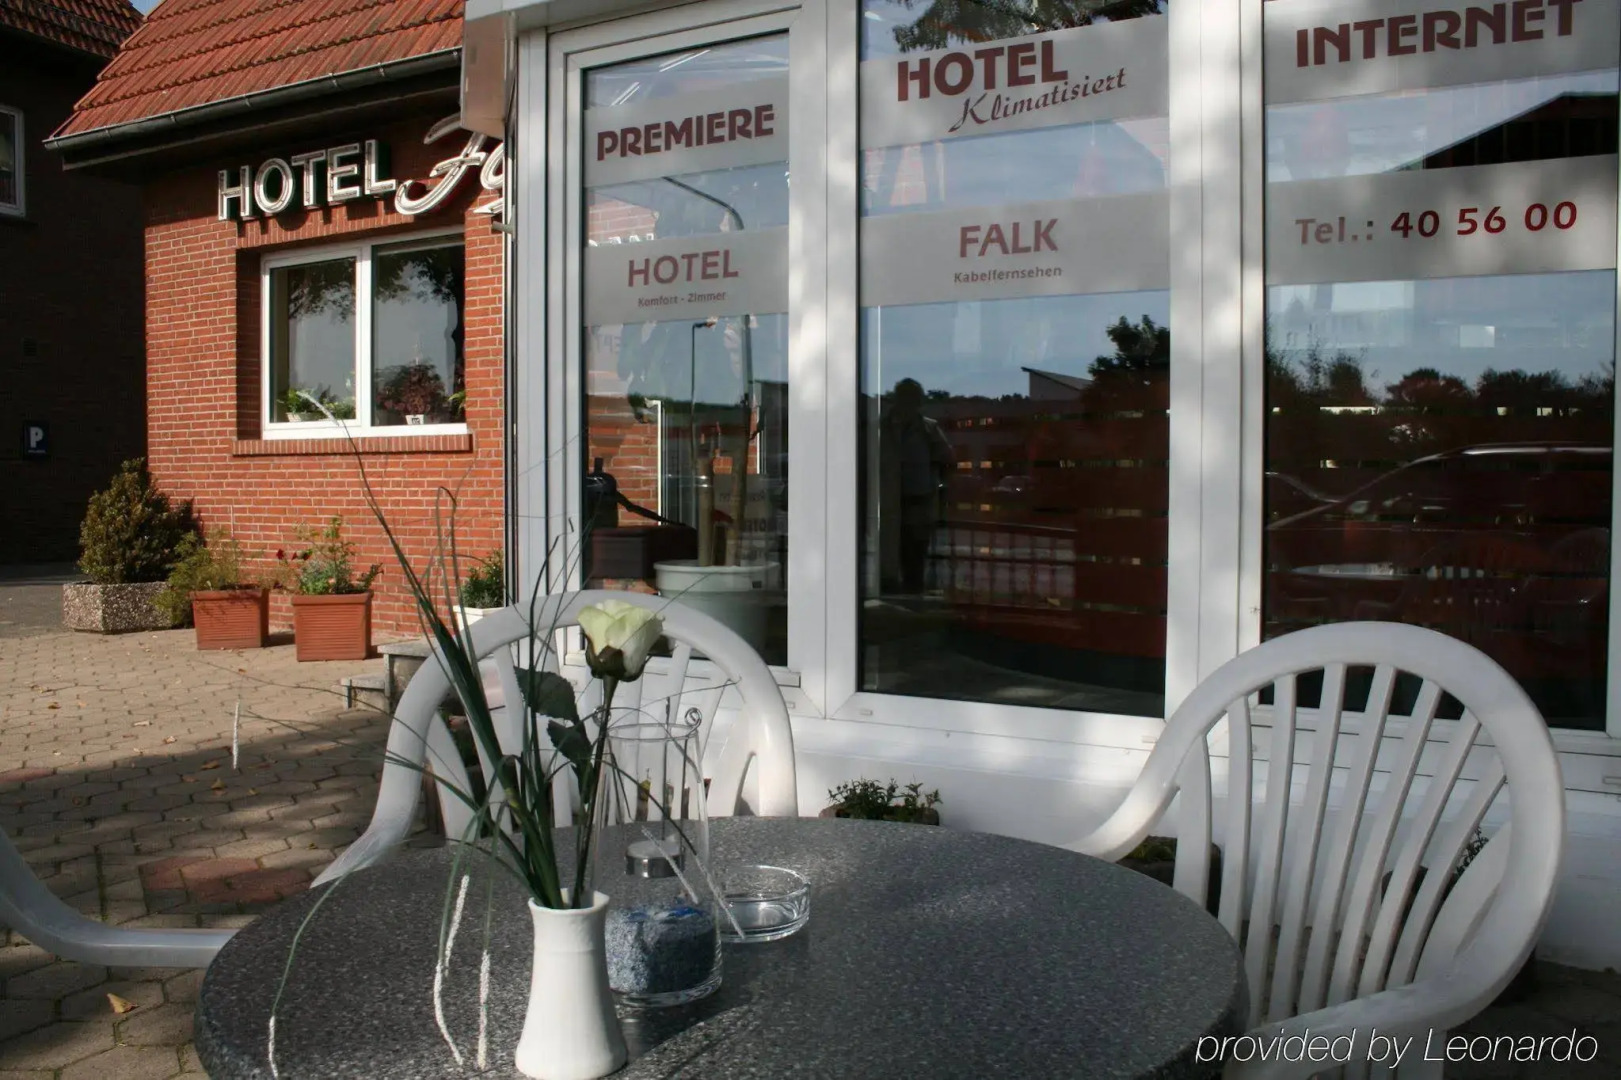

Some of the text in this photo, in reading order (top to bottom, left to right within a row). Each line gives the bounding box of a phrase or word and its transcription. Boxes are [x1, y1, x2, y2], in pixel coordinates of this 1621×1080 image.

[1296, 0, 1582, 68] INTERNET
[897, 39, 1068, 102] HOTEL
[948, 67, 1128, 133] Klimatisiert
[596, 103, 775, 161] PREMIERE
[217, 139, 397, 221] HOTEL
[959, 218, 1059, 258] FALK
[1295, 201, 1578, 245] Tel.: 40 56 00
[627, 249, 740, 288] HOTEL
[953, 265, 1063, 284] Kabelfernsehen
[637, 294, 678, 307] Komfort
[687, 291, 727, 304] Zimmer
[30, 426, 44, 448] P
